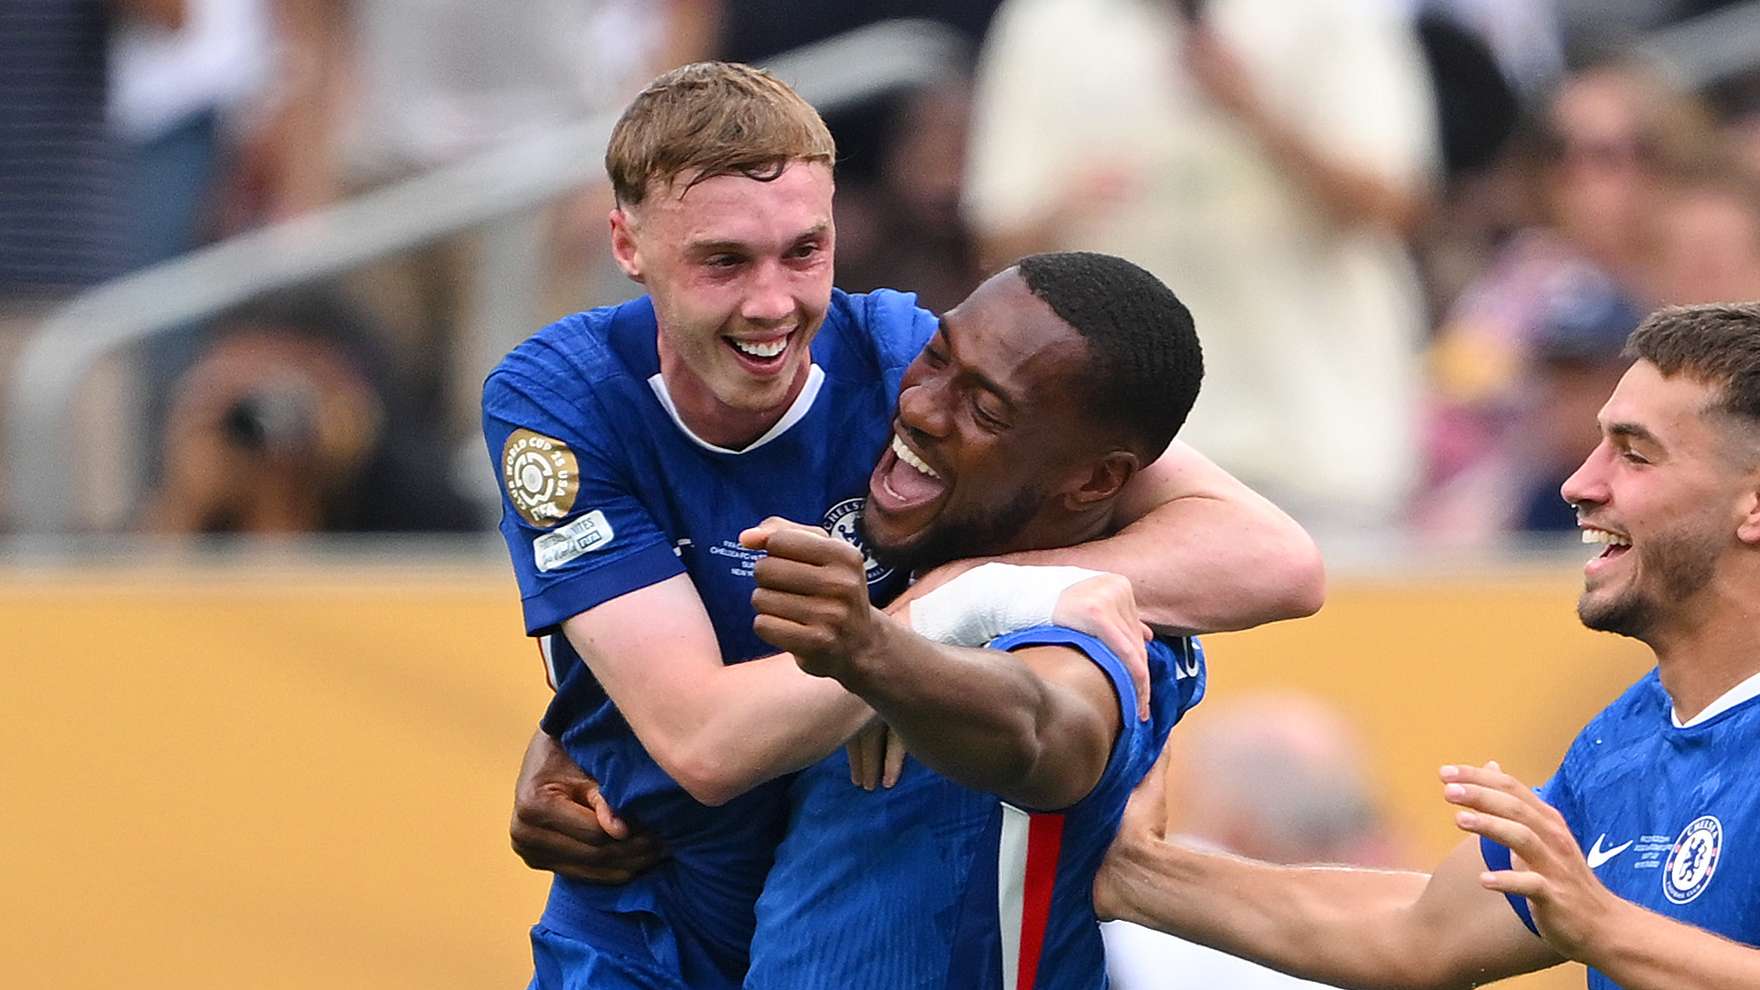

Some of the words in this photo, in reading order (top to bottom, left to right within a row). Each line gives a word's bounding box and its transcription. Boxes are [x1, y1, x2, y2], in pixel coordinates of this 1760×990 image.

[506, 439, 527, 476] WORLD
[528, 437, 552, 451] CUP
[555, 470, 569, 496] USA
[823, 502, 864, 530] CHELS
